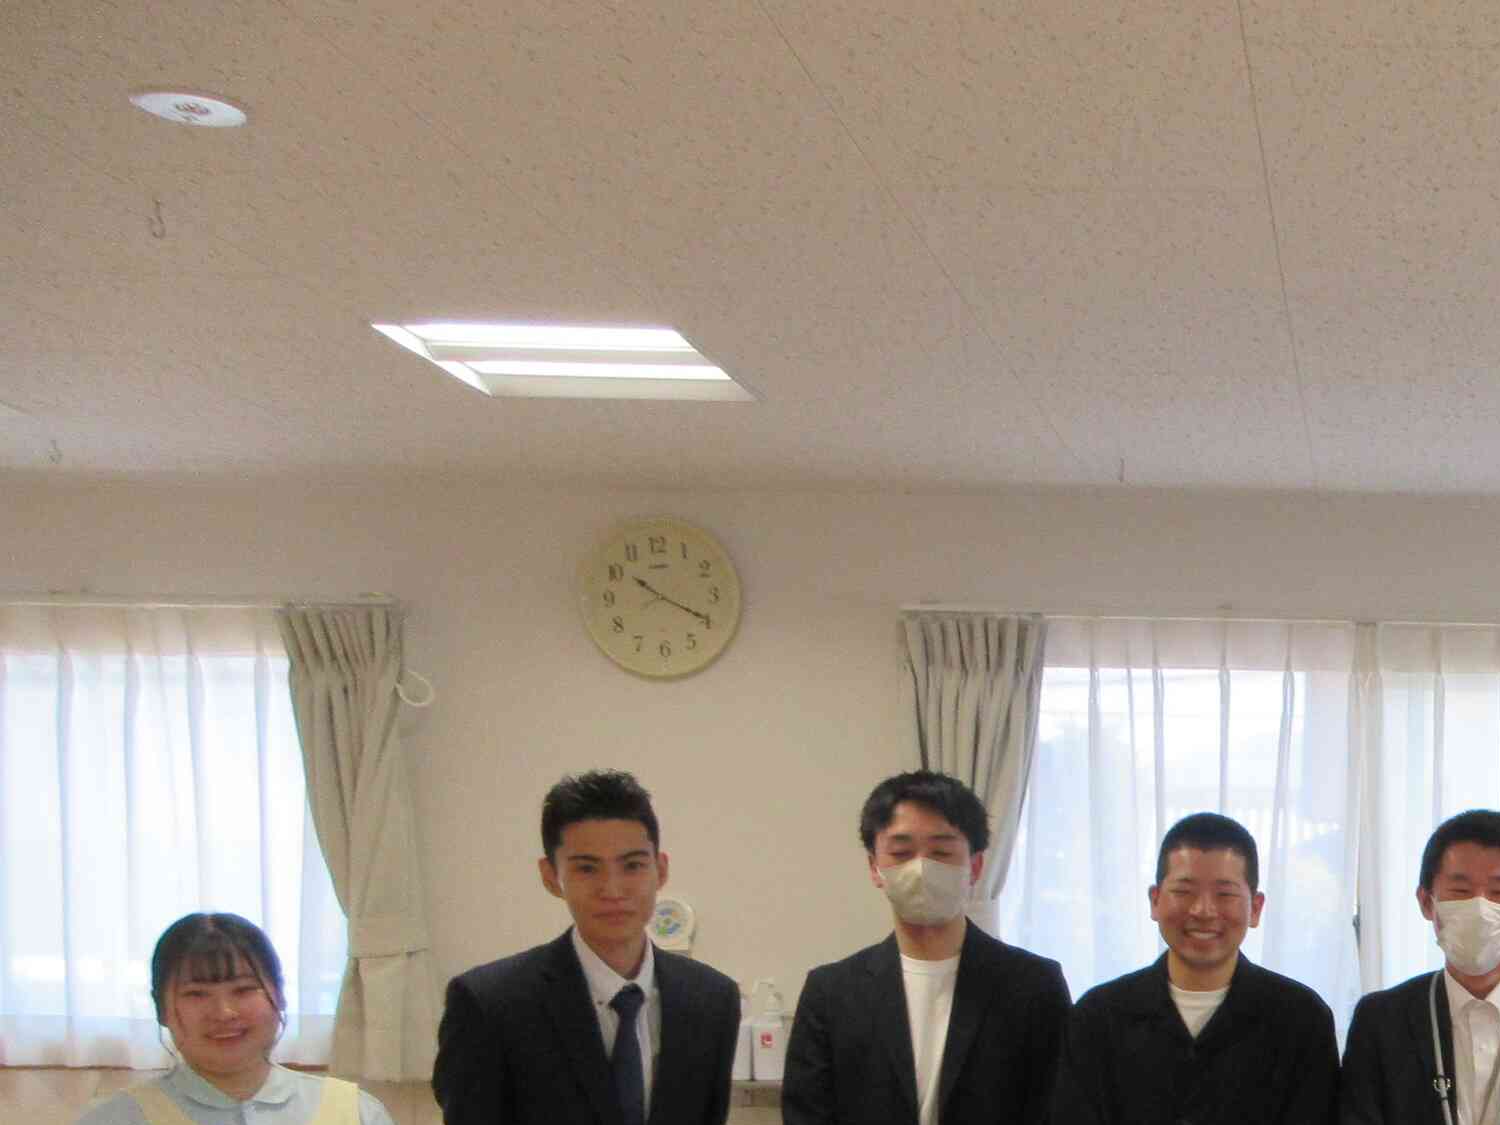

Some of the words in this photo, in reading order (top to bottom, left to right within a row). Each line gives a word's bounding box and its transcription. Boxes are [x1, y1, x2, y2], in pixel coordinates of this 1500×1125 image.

[625, 544, 639, 562] 11
[648, 536, 666, 555] 12
[681, 542, 689, 560] 1
[608, 563, 624, 582] 10
[698, 560, 711, 578] 2
[603, 590, 615, 608] 9
[709, 586, 720, 604] 3
[612, 616, 624, 633] 8
[633, 635, 644, 652] 7
[659, 640, 672, 658] 6
[686, 633, 697, 650] 5
